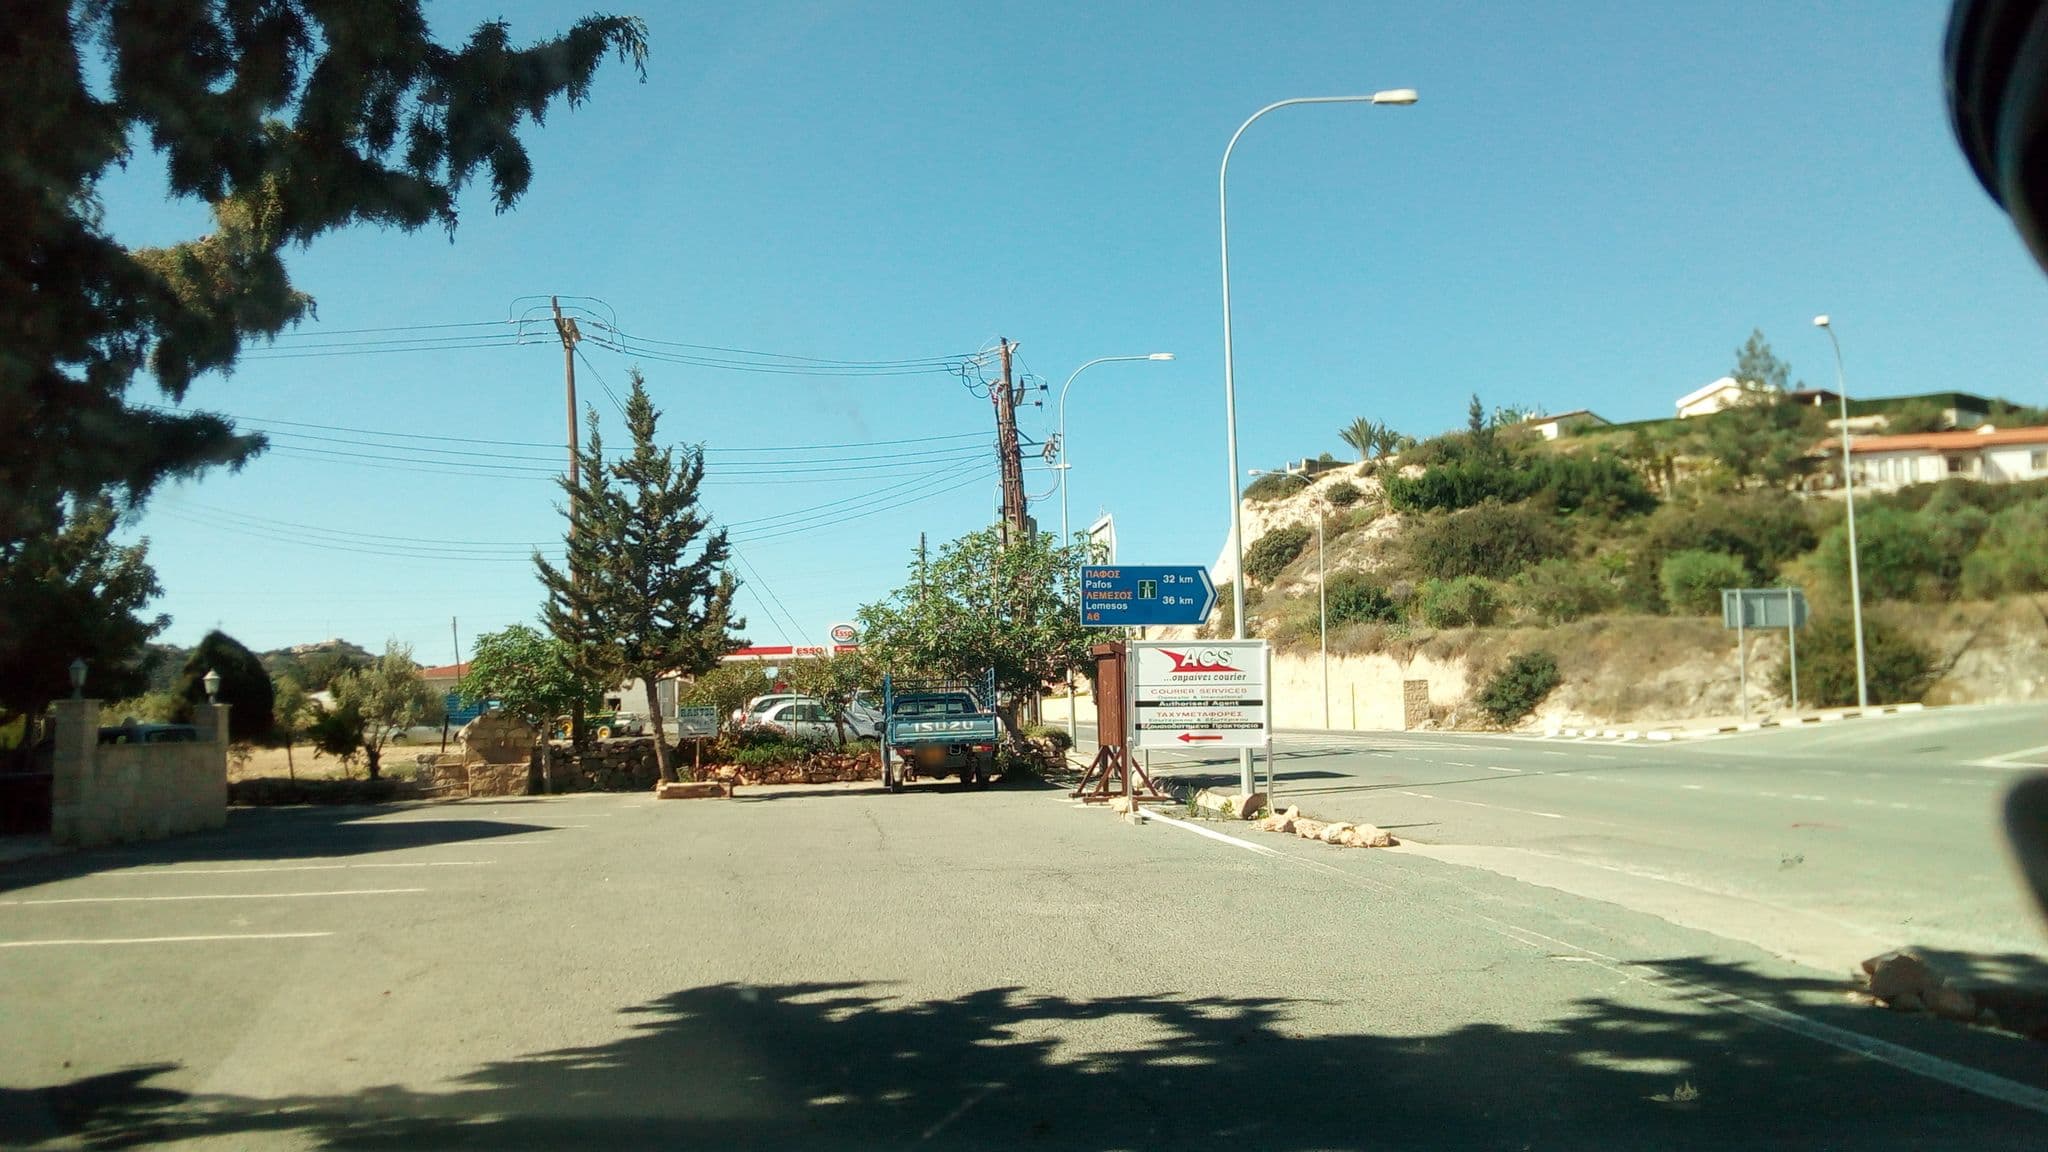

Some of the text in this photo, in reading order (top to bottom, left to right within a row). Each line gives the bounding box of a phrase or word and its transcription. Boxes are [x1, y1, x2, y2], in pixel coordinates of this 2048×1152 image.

[1085, 570, 1121, 579] ΠΑΦΟΣ
[1162, 574, 1194, 584] 32 km
[1085, 580, 1112, 589] Pafos
[1086, 591, 1133, 600] ΛΕΜΕΣΟΣ
[1162, 596, 1194, 605] 36 km
[1085, 601, 1128, 610] Lemesos
[1180, 648, 1234, 668] ACS
[1213, 673, 1247, 681] courier
[914, 720, 974, 732] ISUZU
